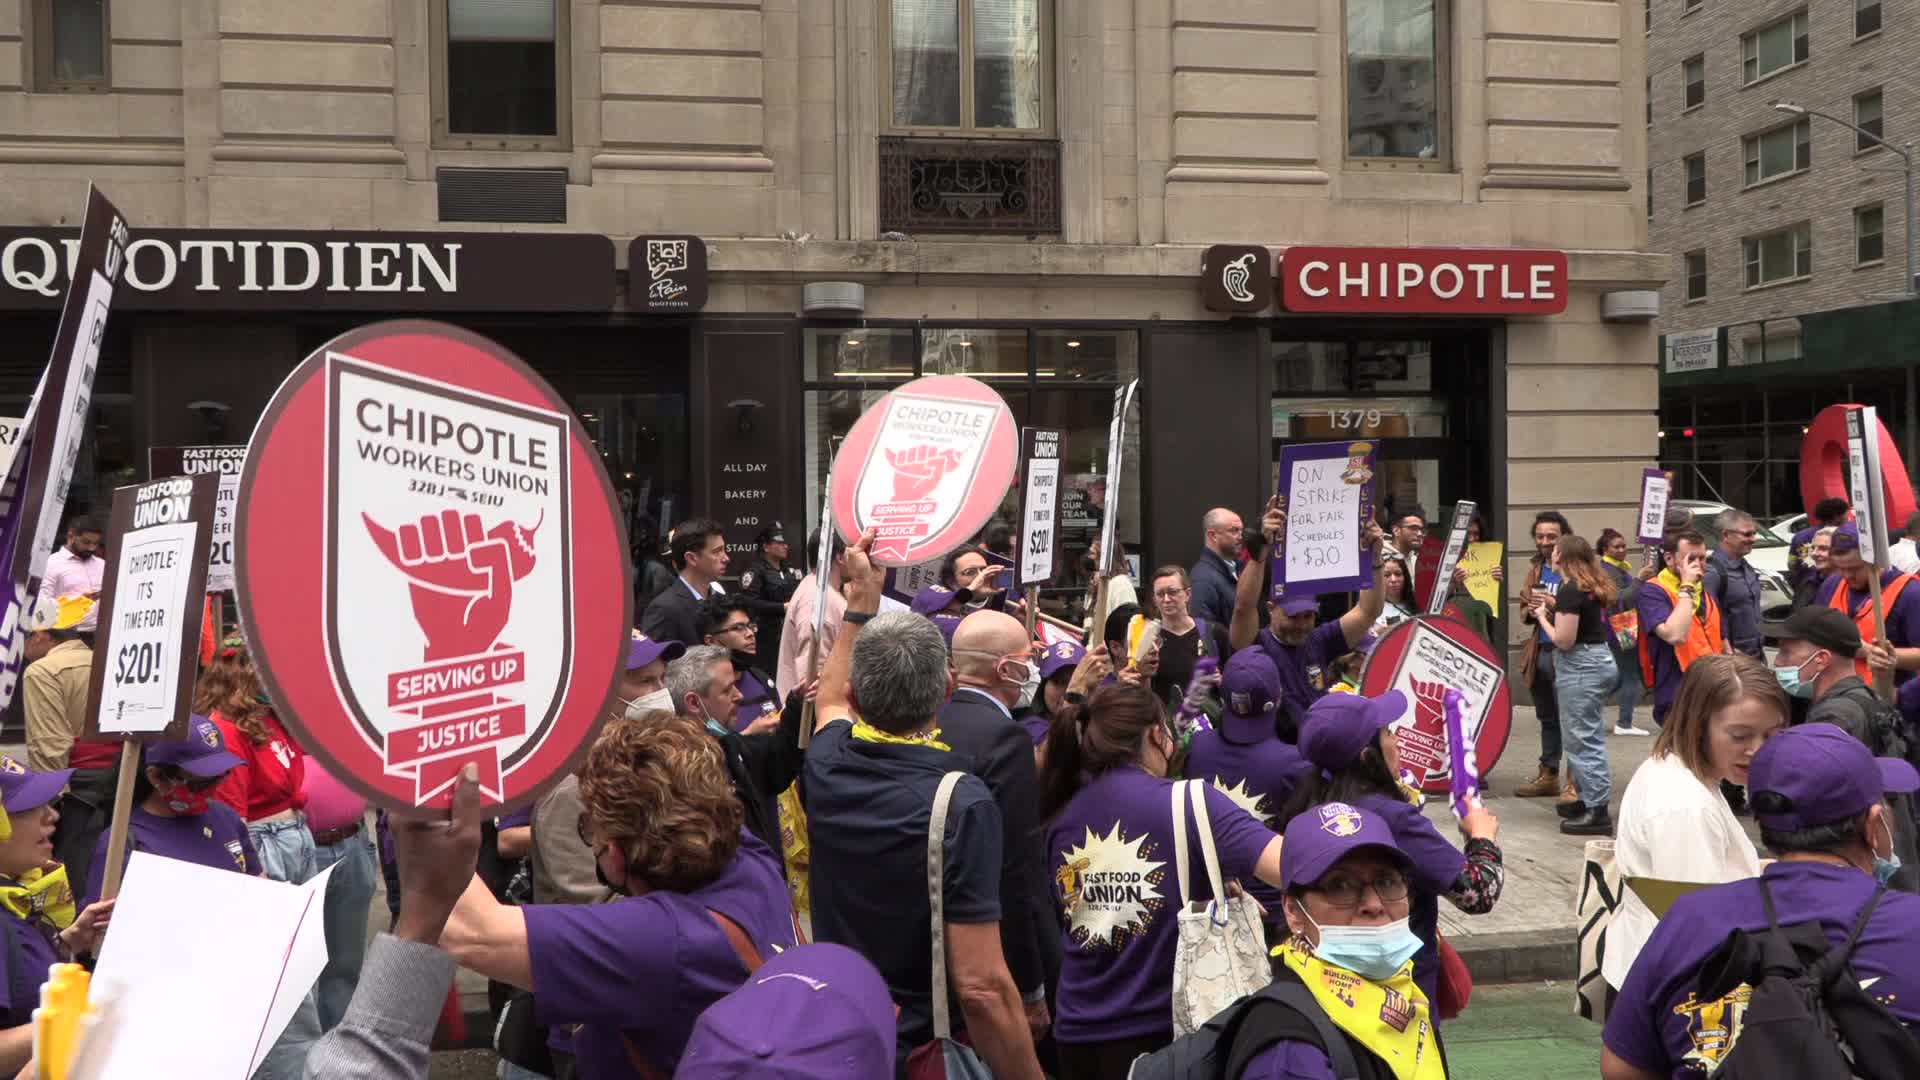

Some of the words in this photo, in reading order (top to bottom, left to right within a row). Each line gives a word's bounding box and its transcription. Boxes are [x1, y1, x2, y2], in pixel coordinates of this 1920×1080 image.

[1299, 261, 1556, 299] CHIPOTLE
[897, 405, 985, 428] CHIPOTLE
[1328, 409, 1381, 429] 1379
[356, 397, 548, 470] CHIPOTLE
[183, 449, 212, 459] FAST
[214, 448, 248, 458] FOOD
[1034, 442, 1058, 458] UNION
[356, 439, 476, 481] WORKERS
[482, 466, 549, 496] UNION
[723, 464, 743, 472] ALL
[746, 463, 768, 472] DAY
[1297, 466, 1324, 485] ON
[136, 485, 157, 503] FAST
[157, 479, 193, 498] FOOD
[408, 479, 445, 496] 32BJ
[470, 491, 504, 507] SEIU
[724, 490, 767, 499] BAKERY
[1296, 487, 1350, 507] STRIKE
[133, 496, 192, 529] UNION
[875, 504, 916, 515] SERVING
[918, 502, 933, 513] UP
[1061, 501, 1082, 510] OUR
[1062, 510, 1088, 518] TEAM
[735, 516, 759, 526] AND
[1291, 512, 1315, 529] FOR
[1319, 511, 1345, 525] FAIR
[876, 525, 917, 536] JUSTICE
[1293, 530, 1345, 545] SCHEDULES
[1030, 528, 1049, 557] $20!
[129, 550, 178, 574] CHIPOTLE:
[1303, 546, 1340, 567] $20
[136, 581, 154, 600] IT'S
[124, 612, 143, 630] TIME
[144, 608, 165, 627] FOR
[115, 642, 162, 688] $20!
[1419, 636, 1490, 687] CHIPOTLE
[396, 663, 486, 699] SERVING
[491, 658, 518, 681] UP
[417, 715, 501, 753] JUSTICE
[1398, 728, 1435, 747] SERVING
[1084, 872, 1108, 884] FAST
[1109, 871, 1142, 882] FOOD
[1083, 885, 1143, 903] UNION
[1323, 968, 1362, 986] BUILDING
[1328, 979, 1353, 990] HOME
